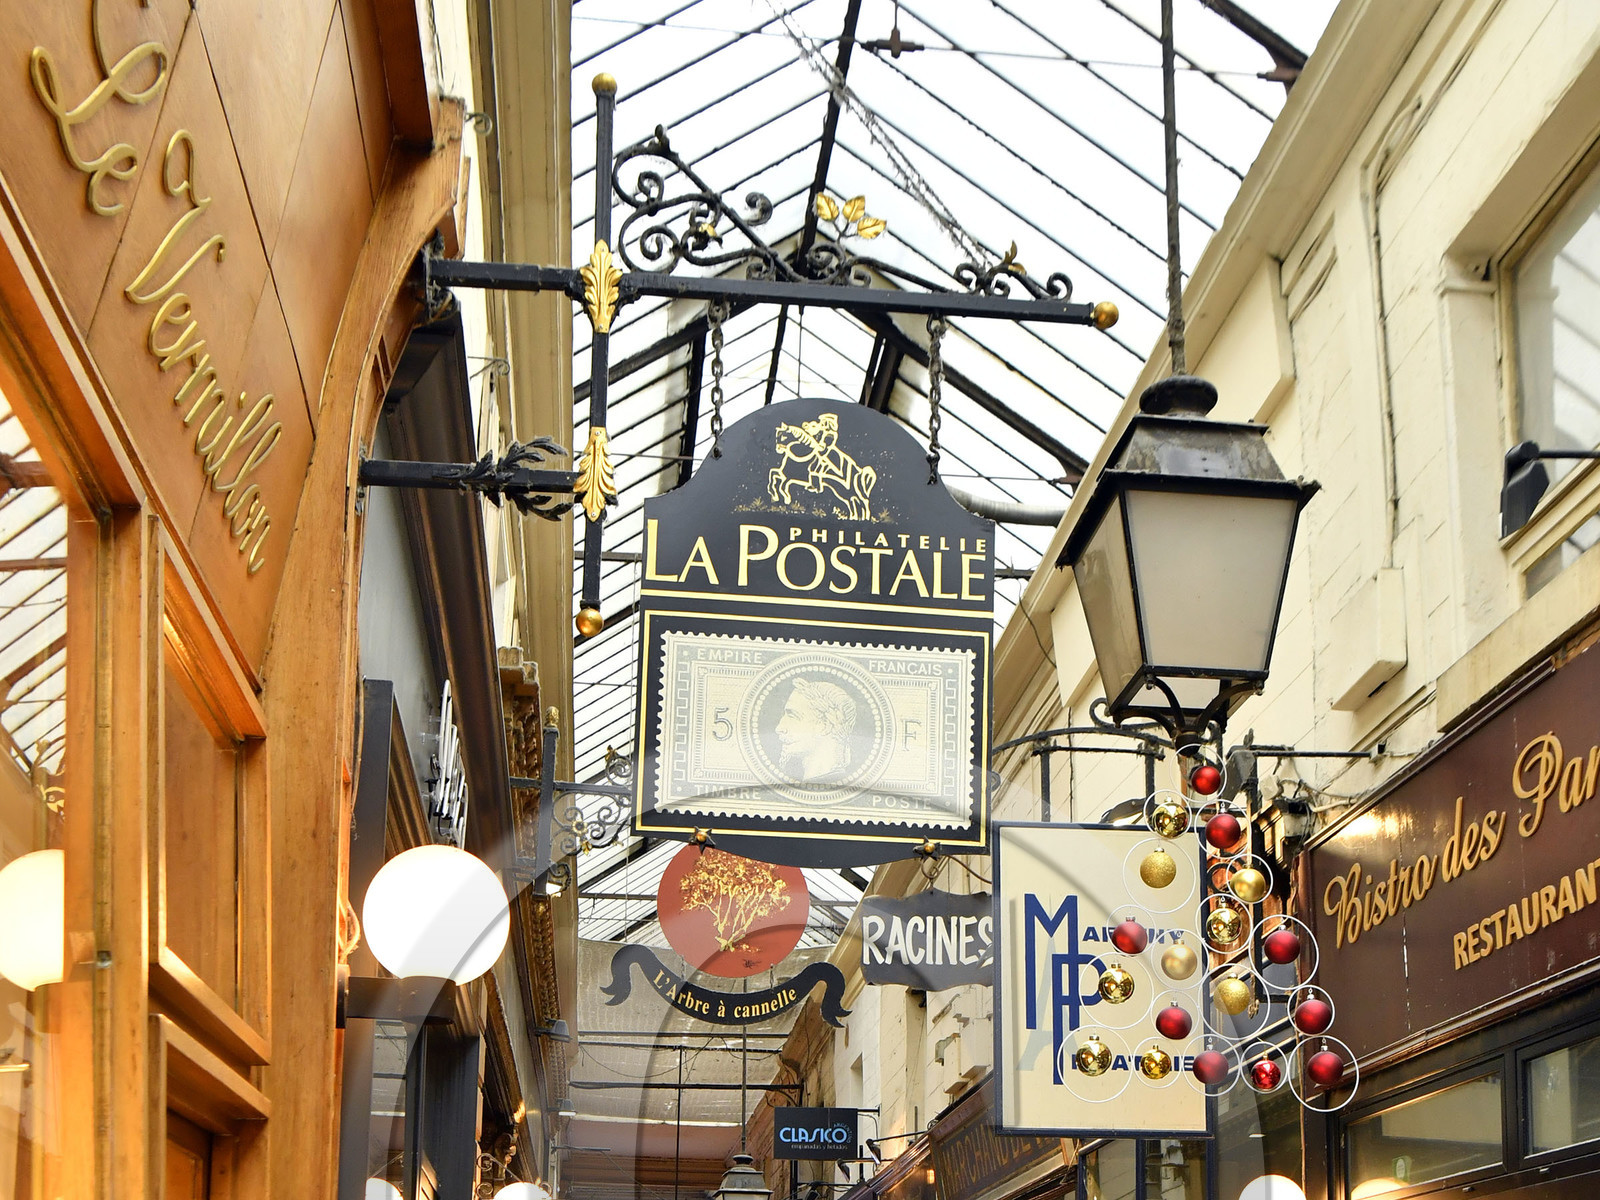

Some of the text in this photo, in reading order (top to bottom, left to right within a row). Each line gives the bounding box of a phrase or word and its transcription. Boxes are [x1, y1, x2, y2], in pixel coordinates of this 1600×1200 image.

[788, 526, 987, 553] PHILATELIE
[646, 518, 987, 602] LA POSTALE
[697, 648, 763, 664] EMPIRE
[711, 707, 735, 741] 5
[694, 784, 932, 810] TIMBRE POSTE
[1323, 853, 1439, 949] Bistro
[1441, 796, 1507, 883] des
[862, 915, 994, 967] RACINES
[733, 987, 797, 1018] cannelle
[779, 1126, 848, 1144] CLASICO
